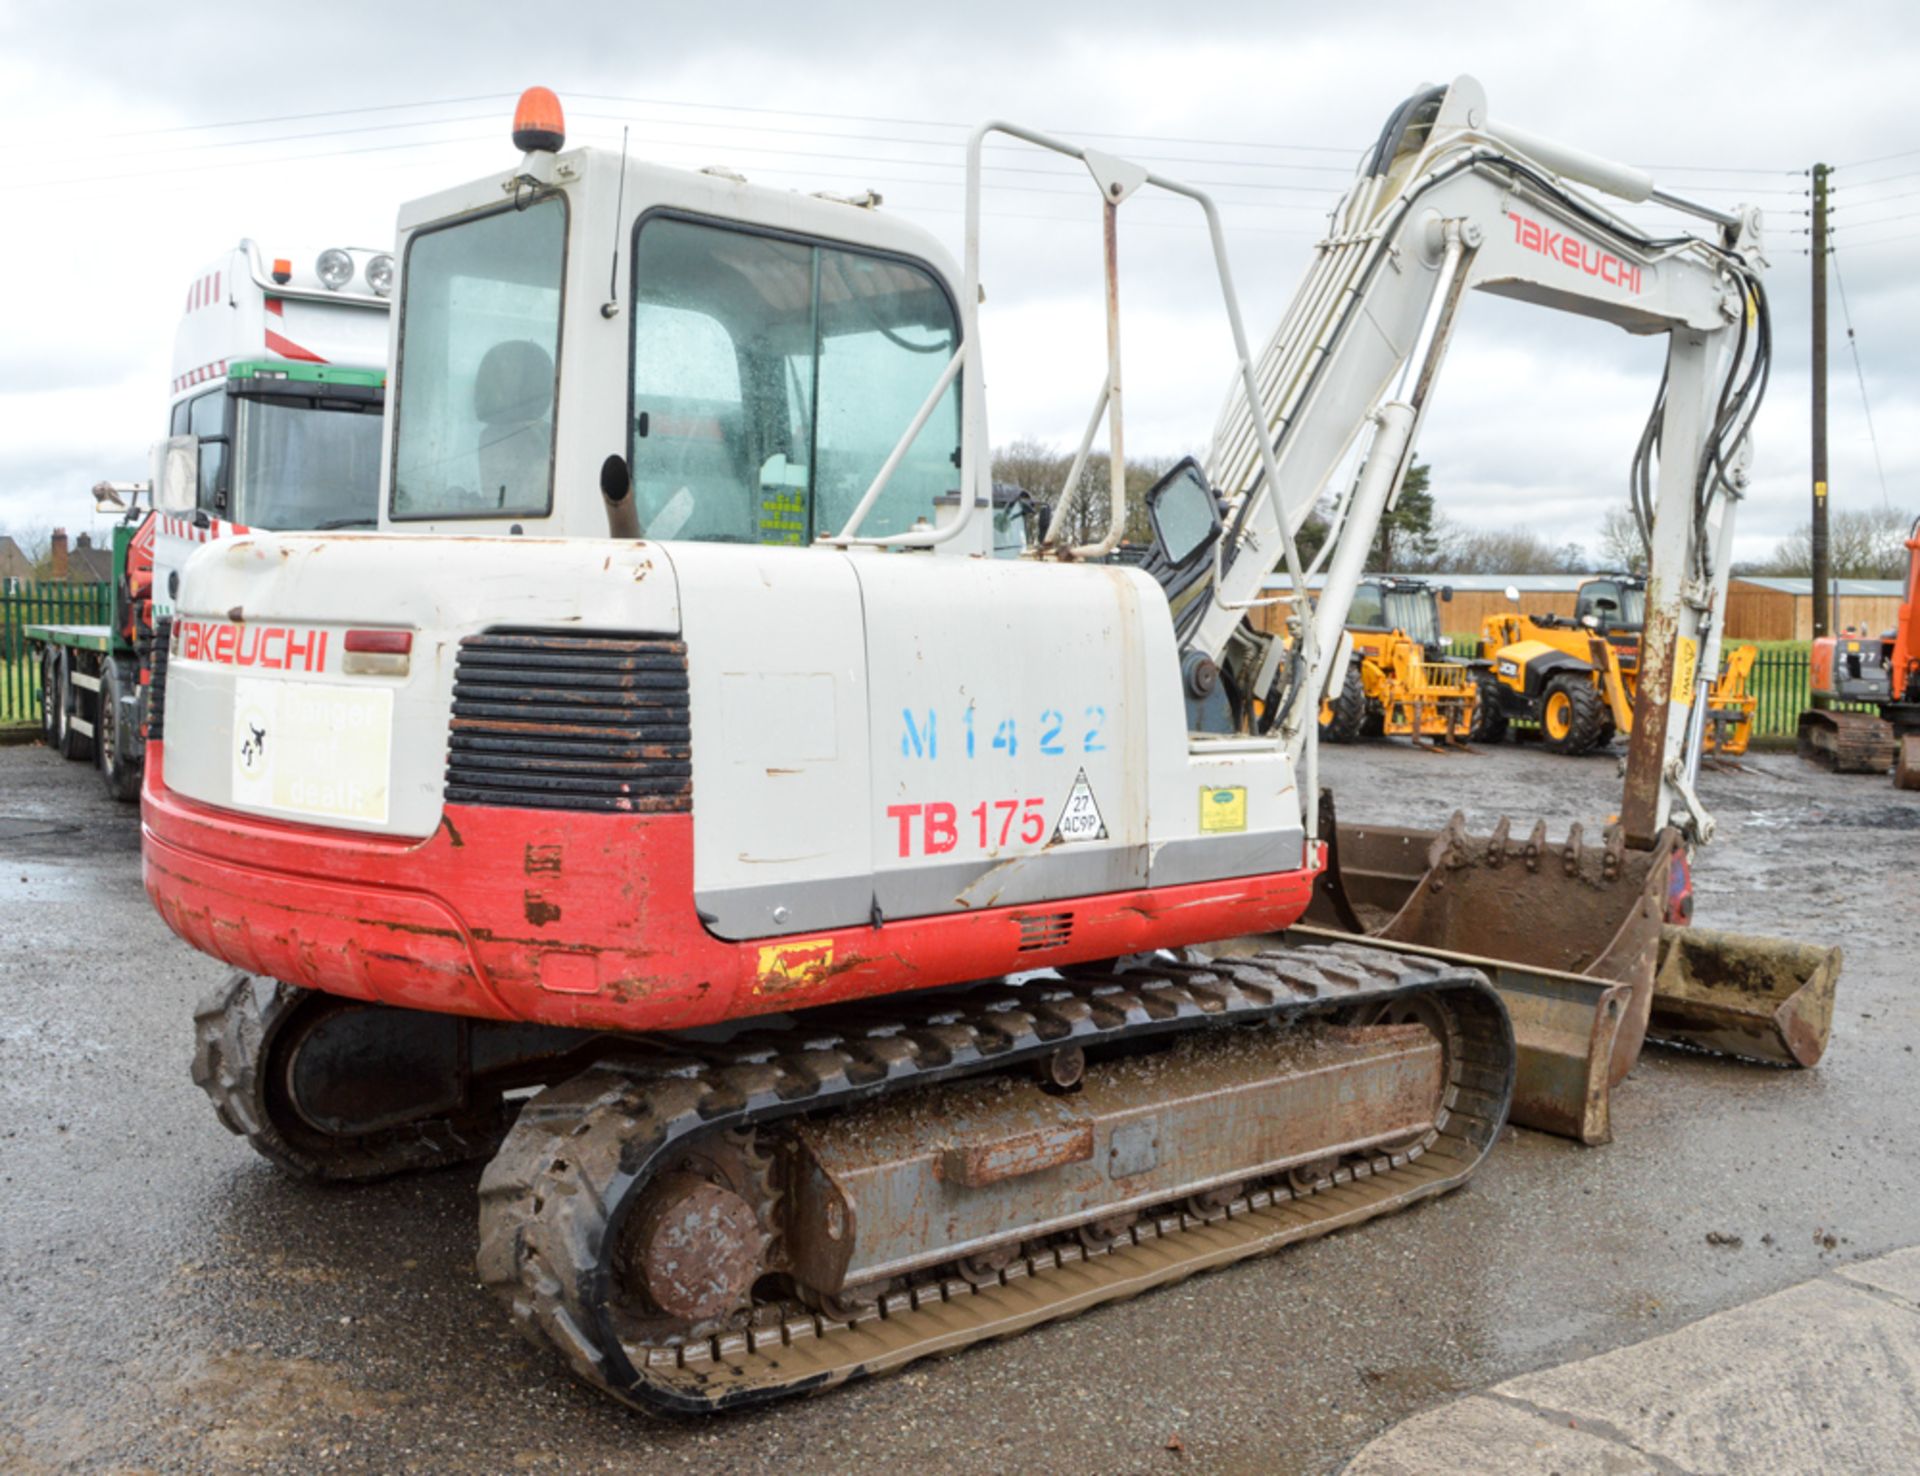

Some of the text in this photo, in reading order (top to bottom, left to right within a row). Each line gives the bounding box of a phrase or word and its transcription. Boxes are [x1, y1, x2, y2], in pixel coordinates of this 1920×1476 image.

[1508, 212, 1641, 294] TAKEUCHI
[183, 622, 328, 672] TAKEUCHI
[1073, 795, 1089, 812] 27
